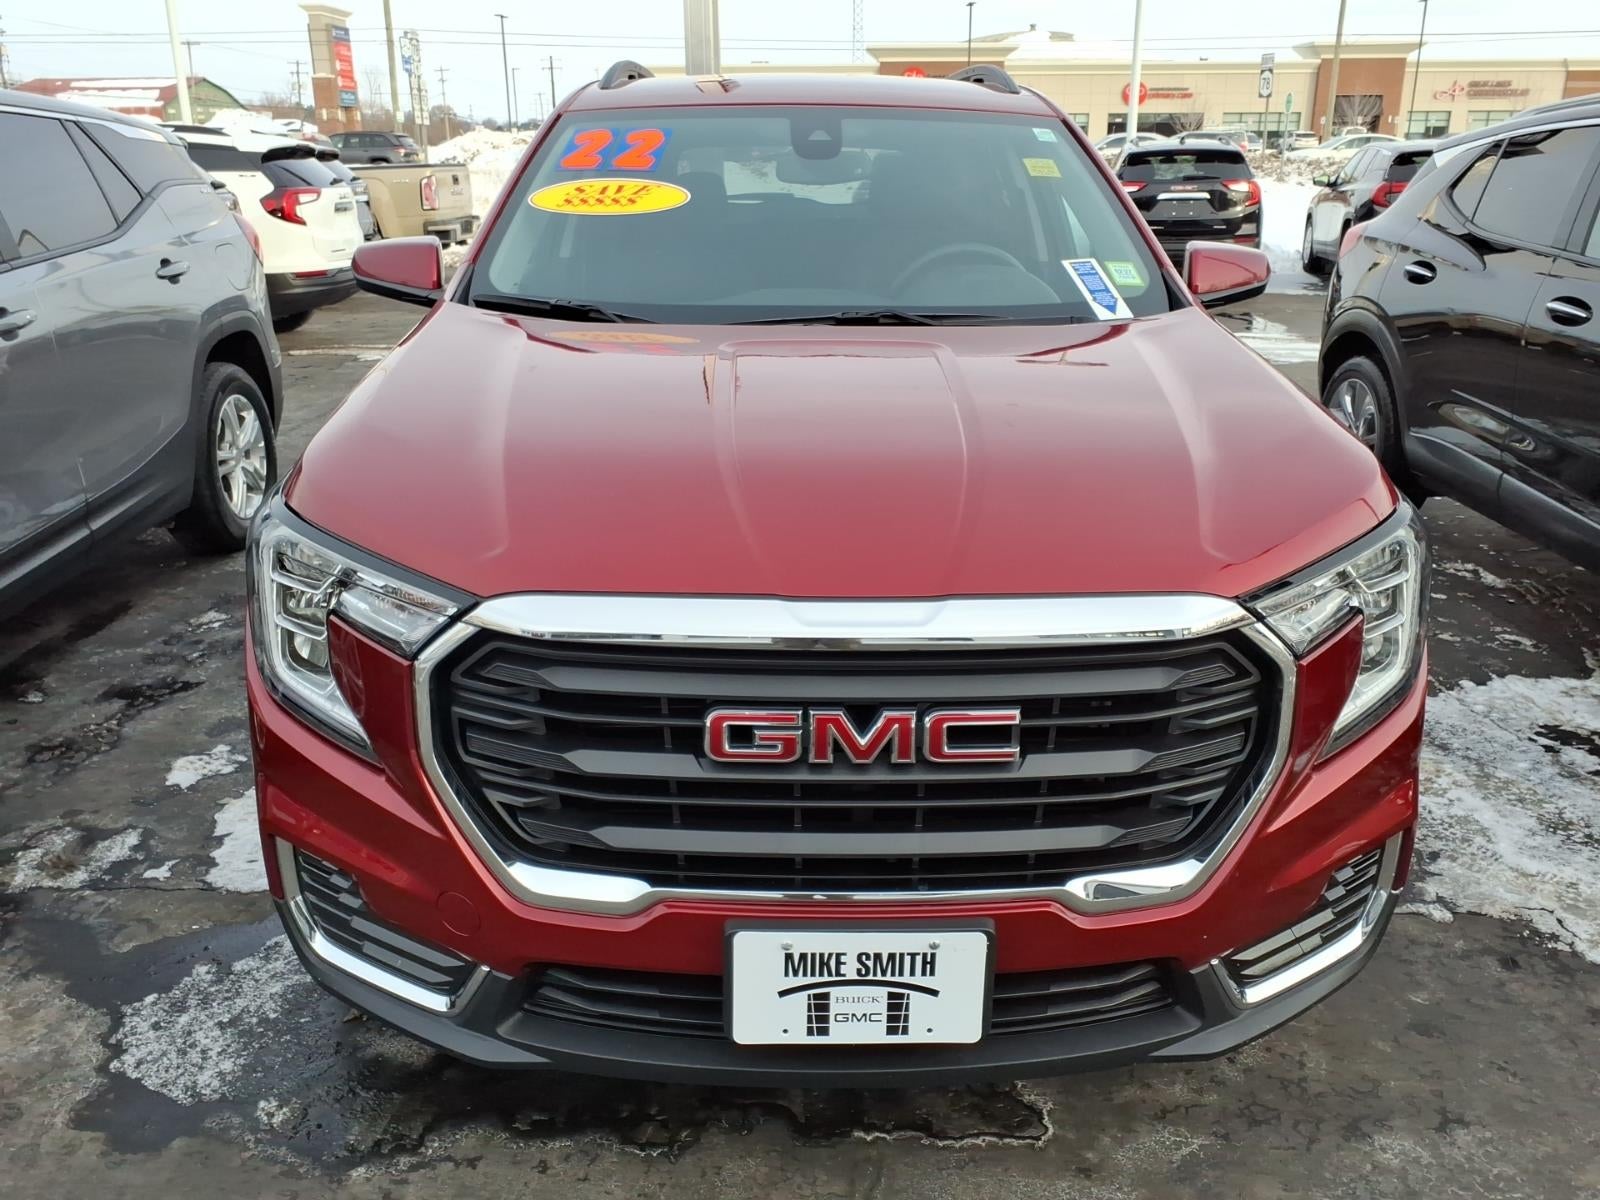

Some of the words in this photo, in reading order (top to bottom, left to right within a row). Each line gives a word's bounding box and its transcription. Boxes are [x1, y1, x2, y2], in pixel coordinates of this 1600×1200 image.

[1262, 77, 1271, 90] 78
[560, 128, 666, 170] 22
[566, 184, 662, 196] SAVE
[704, 707, 1021, 765] GMC
[784, 952, 848, 978] MIKE
[856, 952, 937, 978] SMITH
[834, 996, 883, 1004] BUICK
[833, 1012, 883, 1023] GMC
